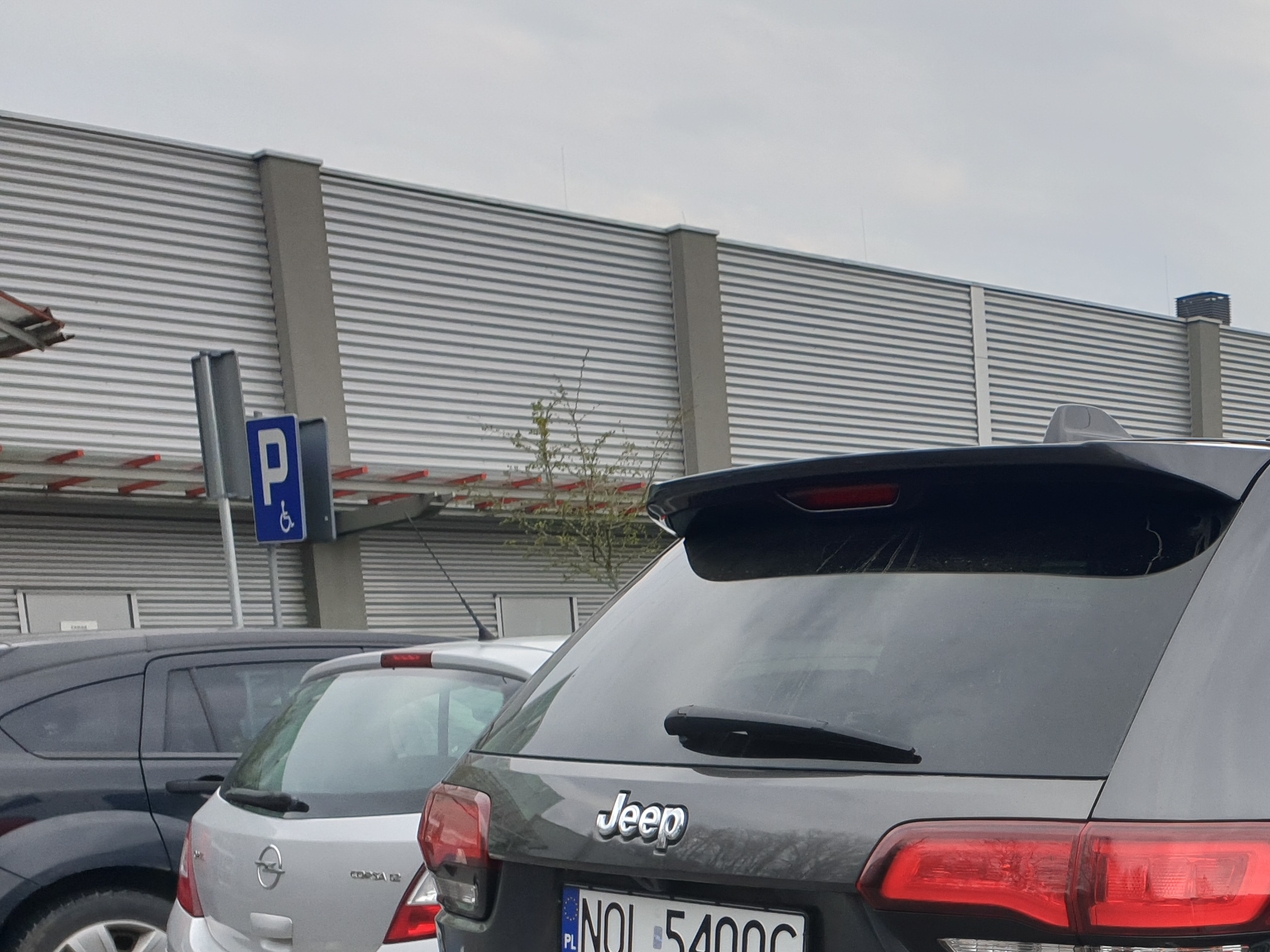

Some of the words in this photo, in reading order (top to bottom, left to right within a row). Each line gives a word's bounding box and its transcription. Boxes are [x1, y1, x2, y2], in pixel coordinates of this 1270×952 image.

[257, 427, 289, 507] P
[597, 789, 690, 855] Jeep
[350, 870, 387, 881] CORSA
[564, 933, 577, 951] PL
